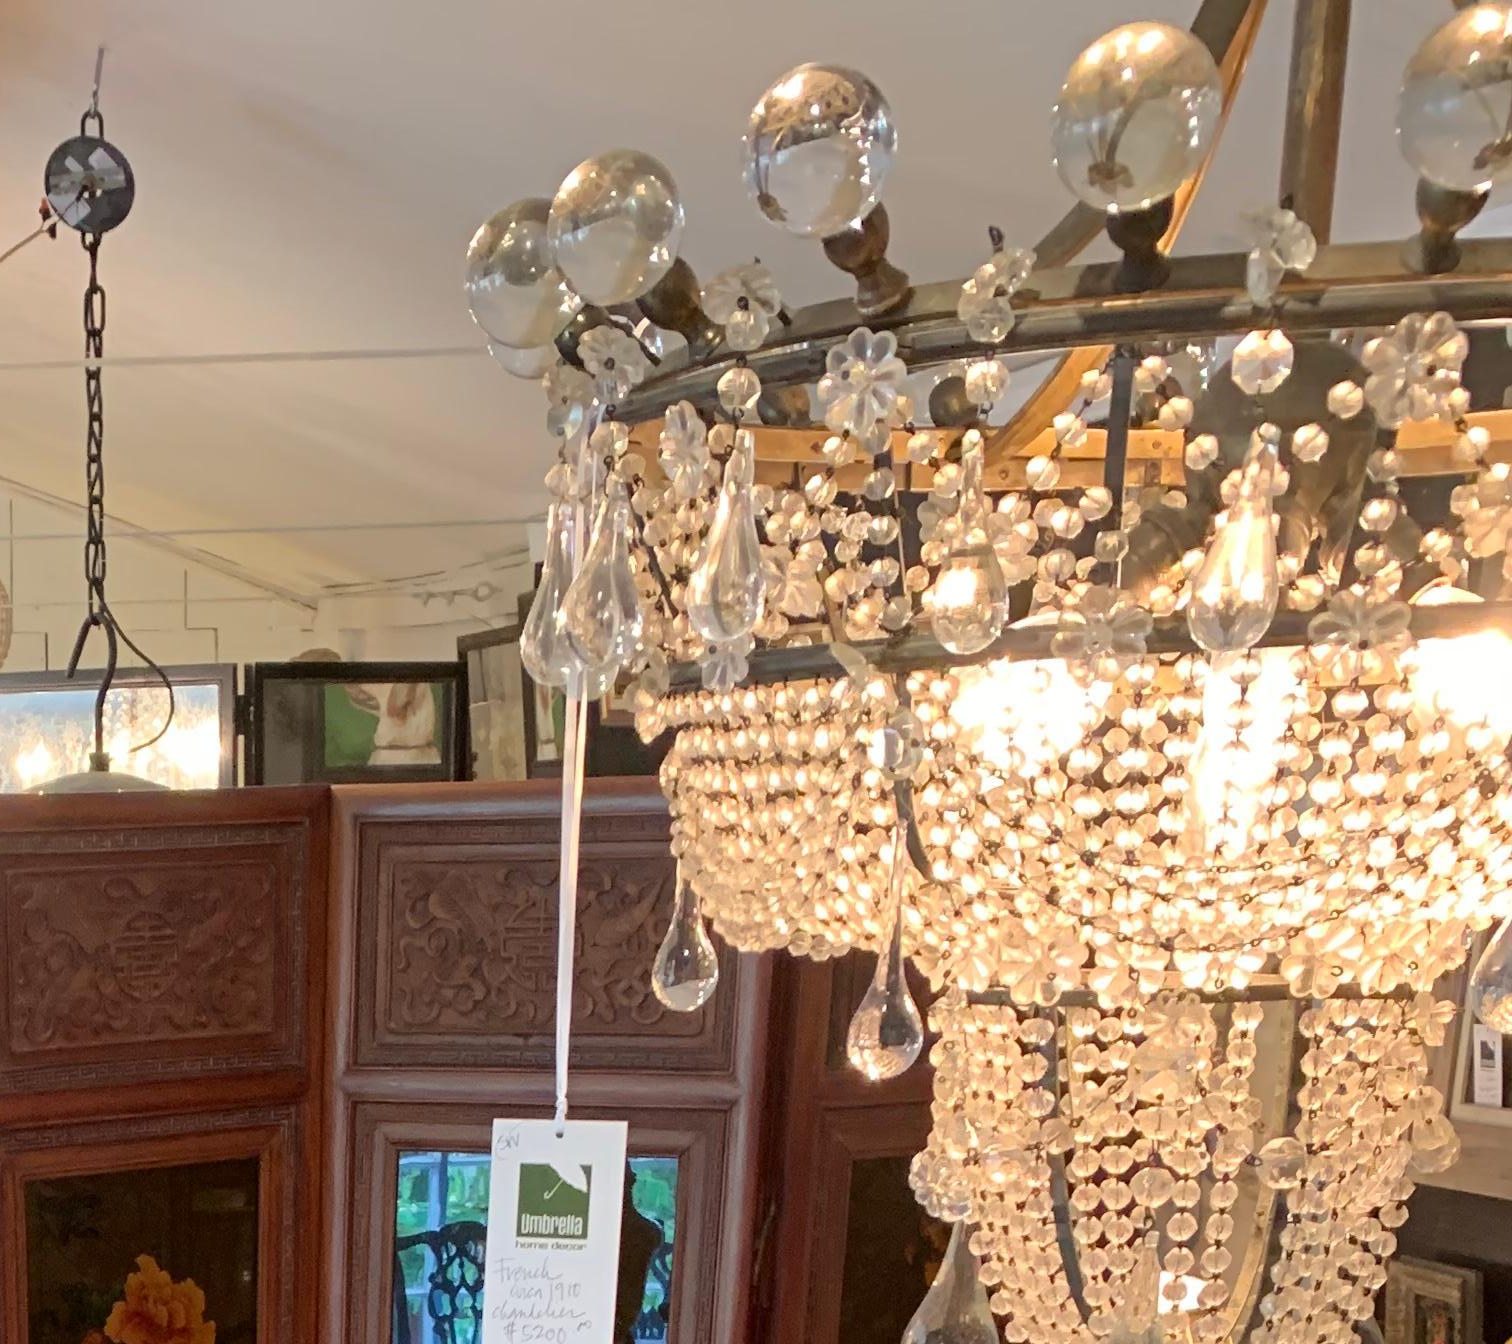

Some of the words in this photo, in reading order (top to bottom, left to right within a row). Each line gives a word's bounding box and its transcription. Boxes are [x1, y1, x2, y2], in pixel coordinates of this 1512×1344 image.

[521, 1213, 583, 1236] Umbrella
[515, 1240, 548, 1249] home
[551, 1241, 587, 1250] decor
